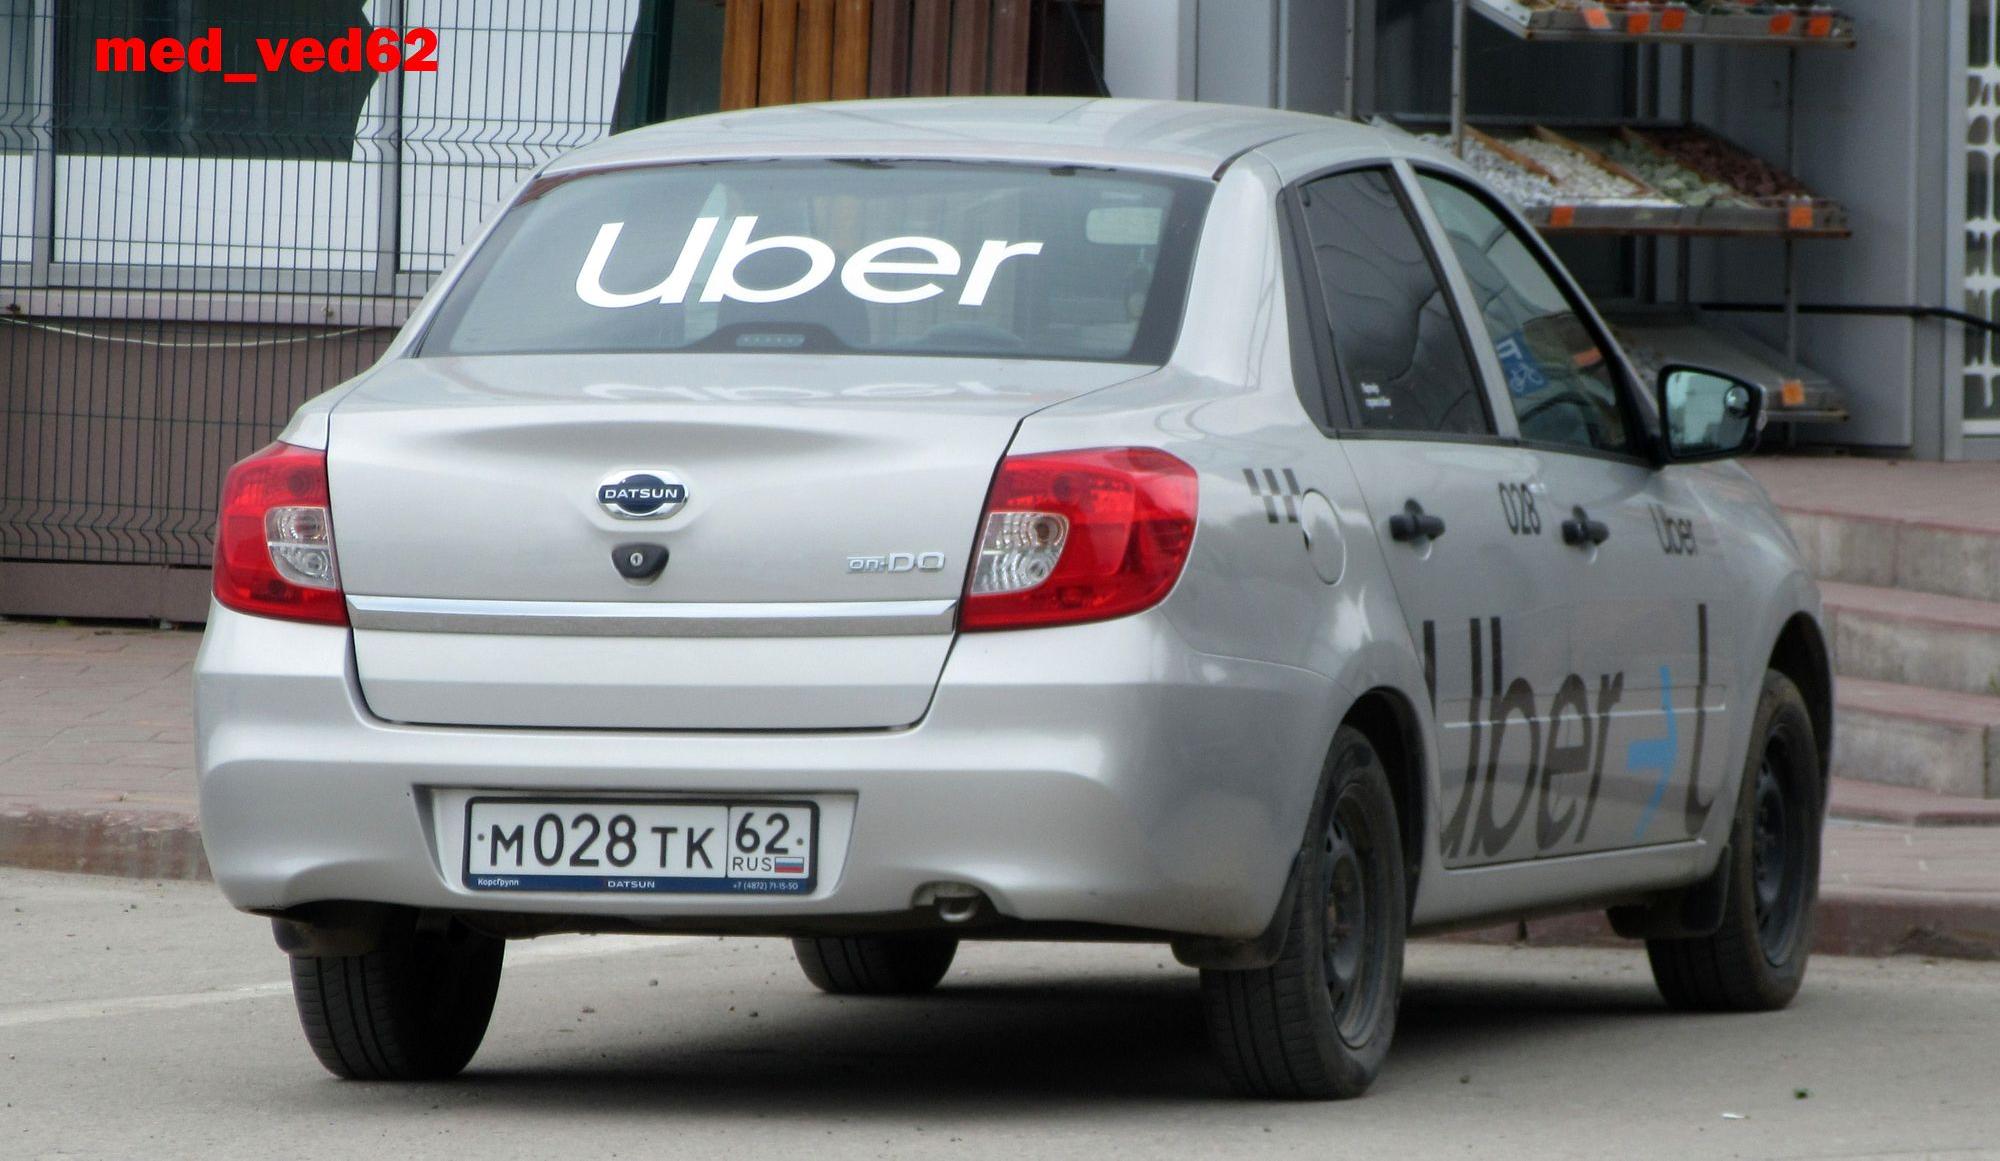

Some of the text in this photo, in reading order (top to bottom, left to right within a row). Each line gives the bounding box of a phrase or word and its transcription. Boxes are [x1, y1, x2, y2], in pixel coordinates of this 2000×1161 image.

[575, 215, 1043, 308] Uber
[604, 487, 678, 500] DATSUN
[1498, 481, 1541, 536] 028
[735, 812, 790, 855] 62
[732, 856, 772, 873] RUS
[607, 880, 656, 889] DATSUN
